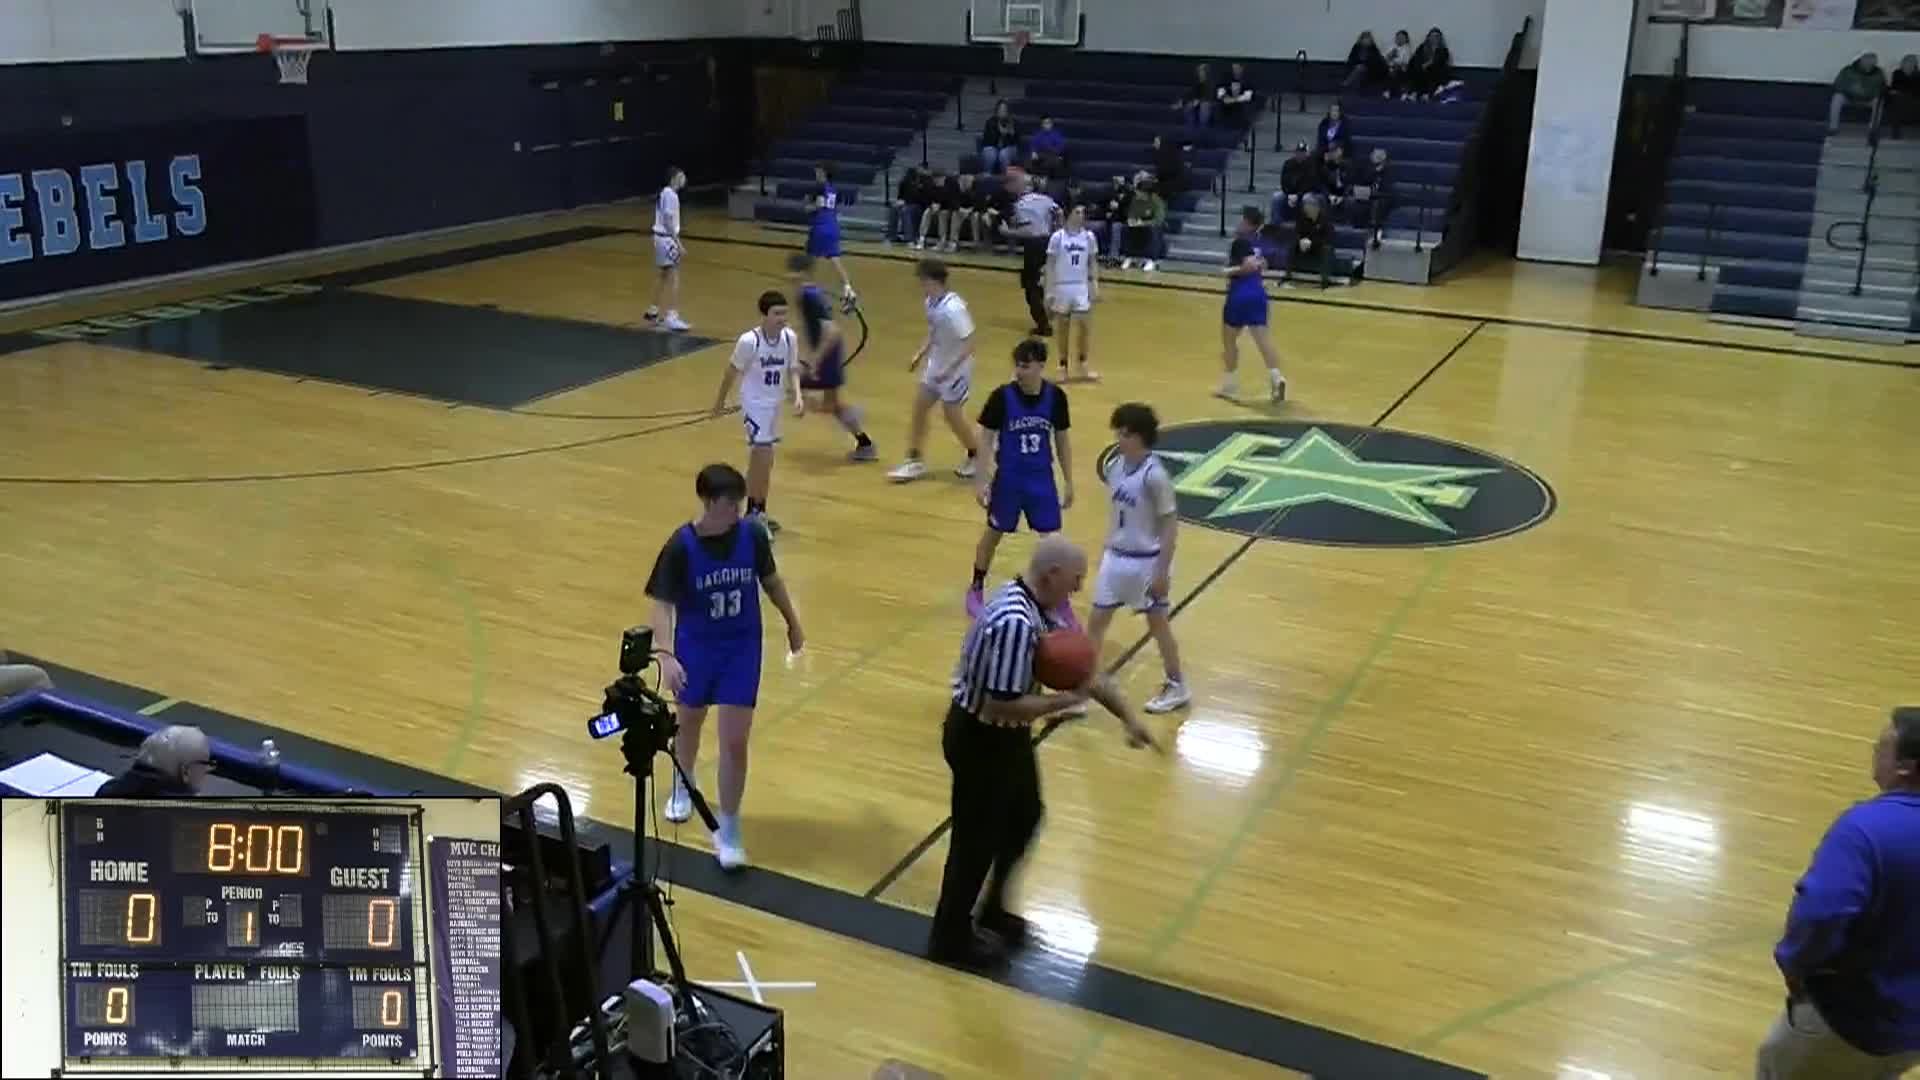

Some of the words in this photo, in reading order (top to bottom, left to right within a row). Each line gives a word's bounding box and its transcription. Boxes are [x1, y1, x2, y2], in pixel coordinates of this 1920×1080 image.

[1020, 434, 1040, 453] 13
[710, 590, 741, 619] 33
[208, 824, 304, 873] 8:00
[450, 842, 476, 856] MVC
[90, 860, 149, 882] HOME
[330, 866, 390, 889] GUEST
[221, 886, 263, 899] PERIOD
[206, 898, 212, 910] P
[272, 900, 279, 911] P
[128, 893, 156, 943] 0
[206, 912, 218, 923] TO
[268, 914, 280, 925] TO
[368, 899, 395, 947] 0
[246, 911, 253, 943] 1
[71, 962, 91, 977] TM
[98, 963, 139, 978] FOULS
[195, 964, 245, 979] PLAYER
[260, 966, 300, 980] FOULS
[349, 967, 368, 980] TM
[373, 968, 411, 981] FOULS
[106, 987, 128, 1024] 0
[382, 991, 402, 1026] 0
[84, 1031, 127, 1046] POINTS
[226, 1034, 266, 1047] MATCH
[362, 1034, 403, 1048] POINTS
